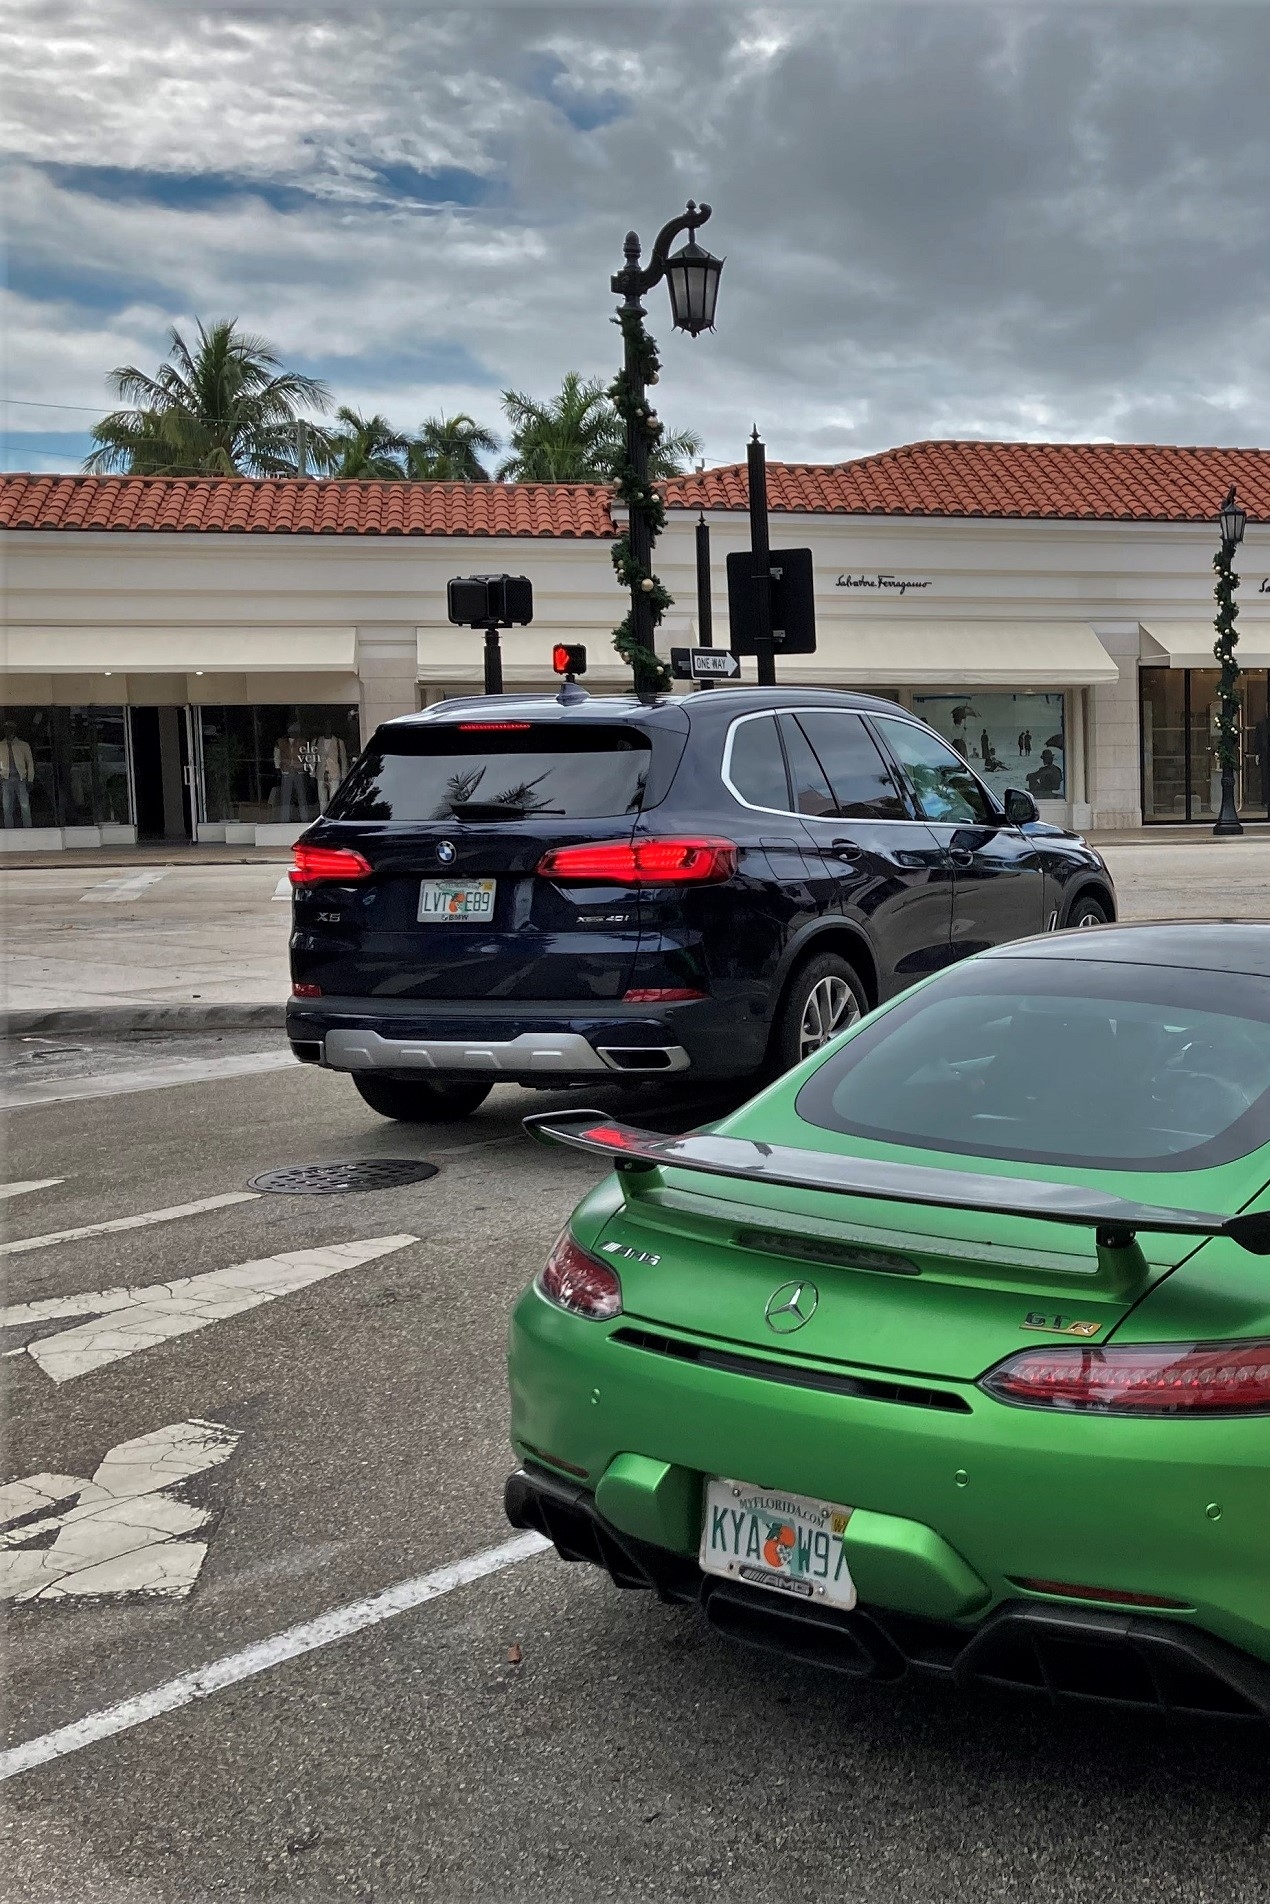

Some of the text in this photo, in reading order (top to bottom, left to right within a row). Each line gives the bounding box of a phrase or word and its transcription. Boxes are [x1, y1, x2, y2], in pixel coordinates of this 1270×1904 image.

[836, 574, 932, 595] Salvatore Ferragamo
[696, 657, 726, 669] ONE WAY
[298, 741, 318, 754] ele
[297, 754, 321, 763] ven
[303, 763, 316, 777] ty
[424, 892, 490, 912] LVT E89
[712, 1505, 844, 1582] KYA W97
